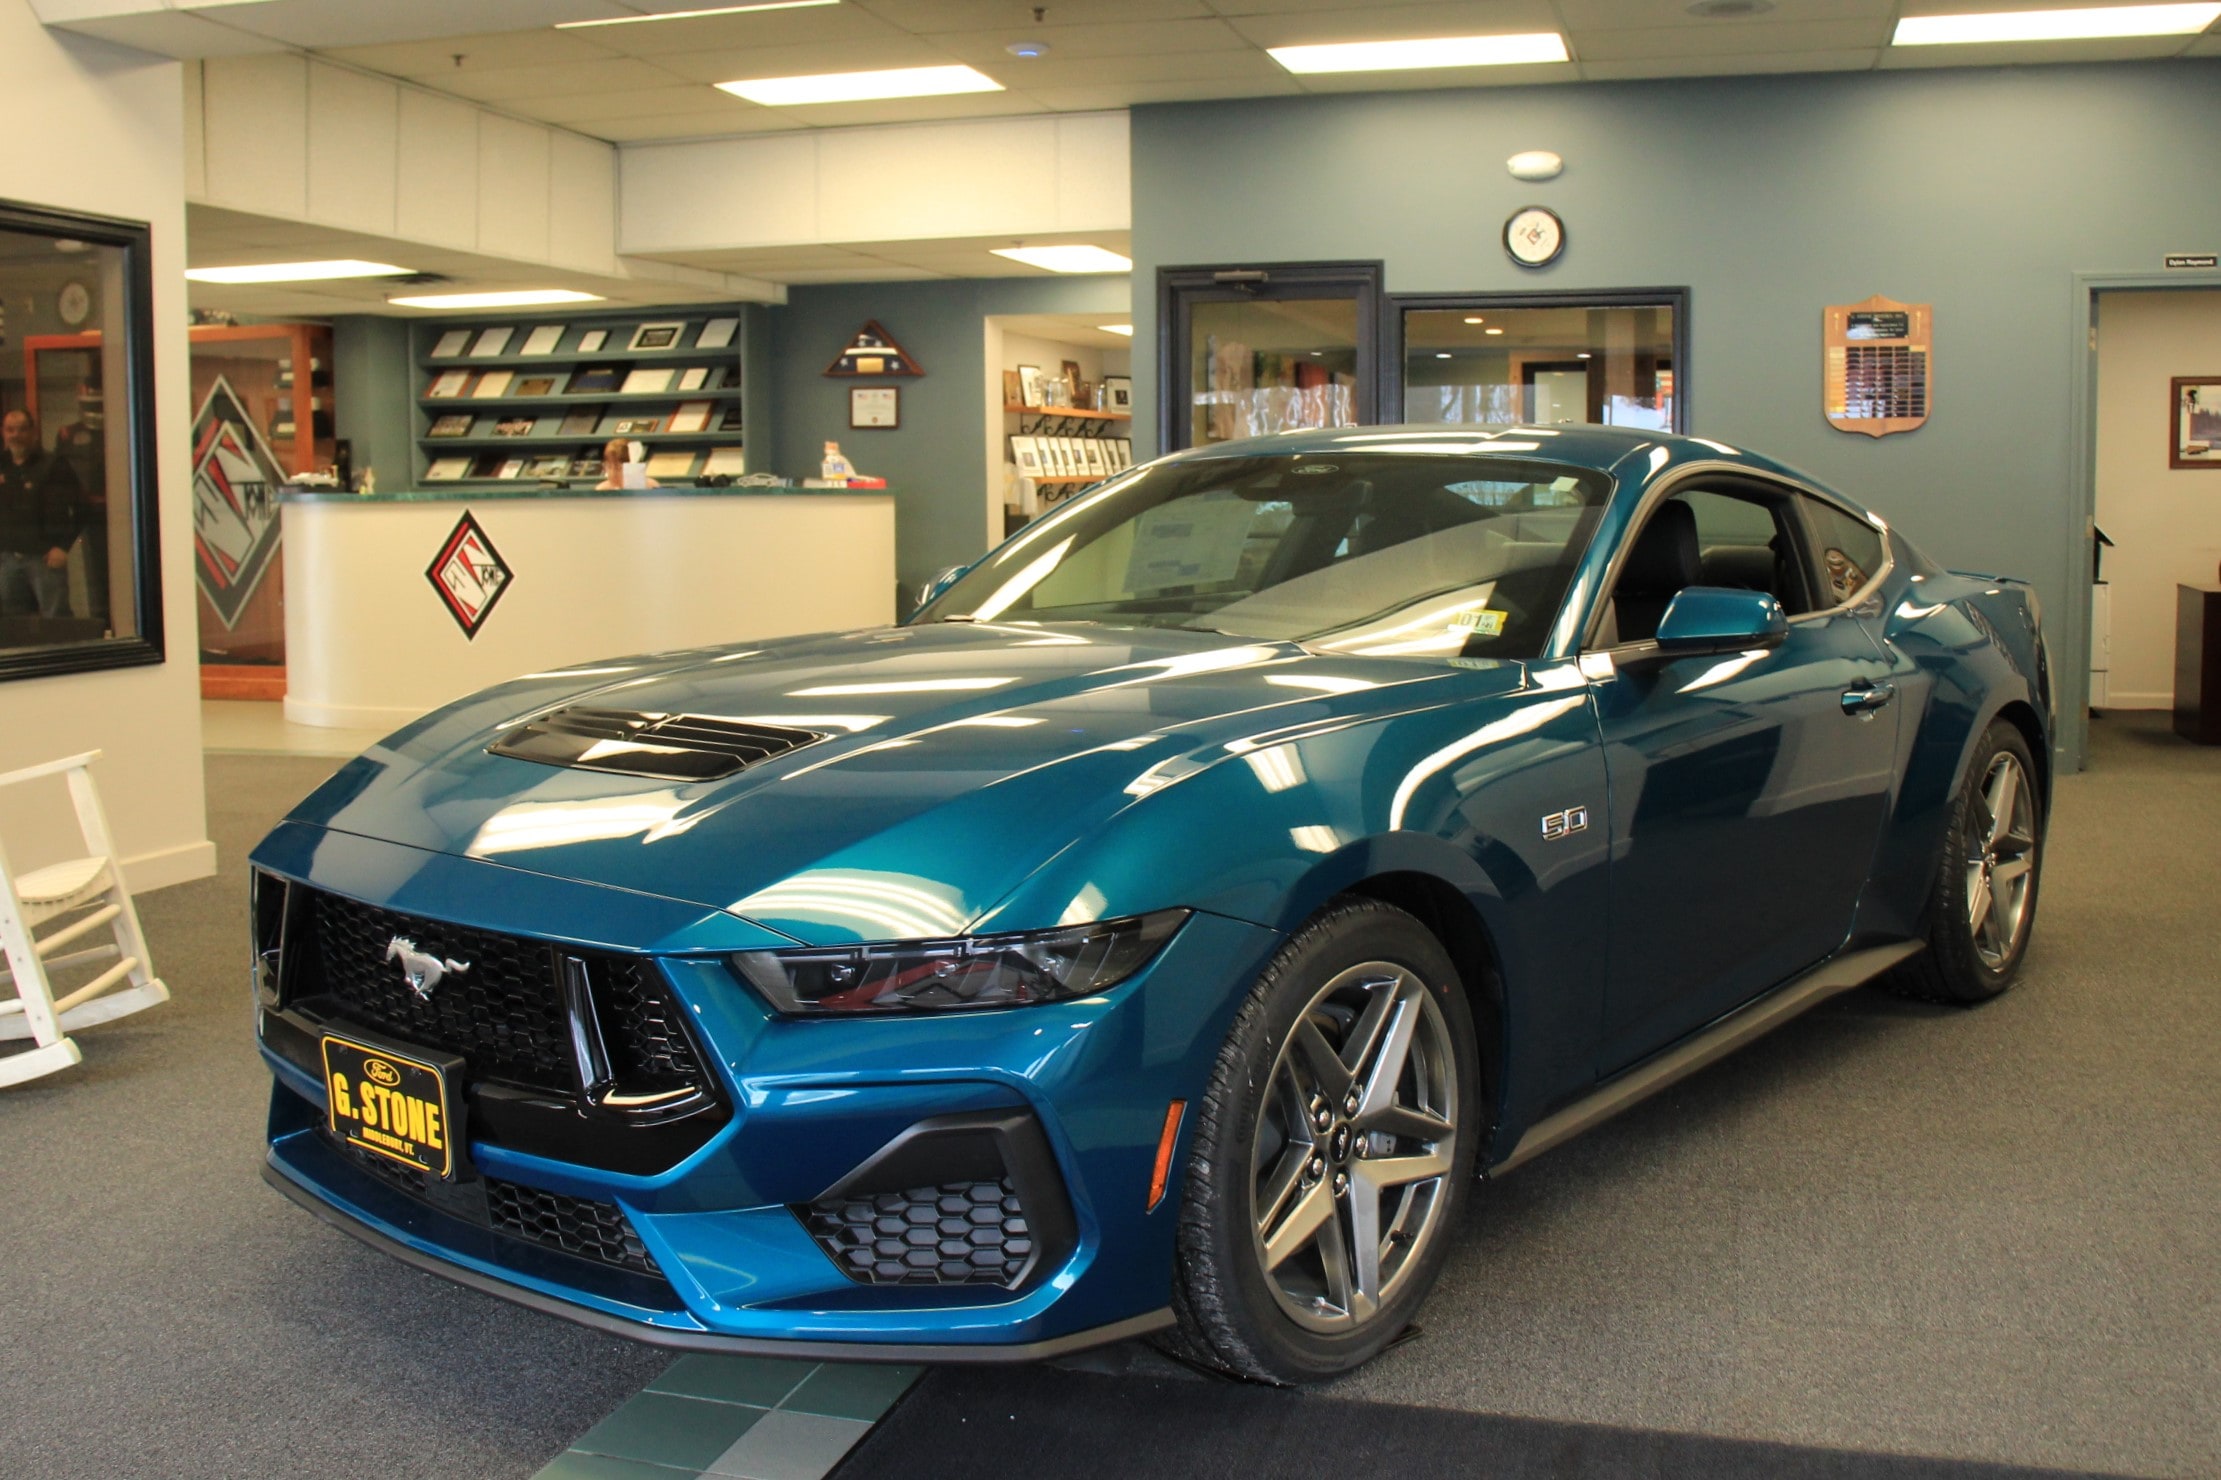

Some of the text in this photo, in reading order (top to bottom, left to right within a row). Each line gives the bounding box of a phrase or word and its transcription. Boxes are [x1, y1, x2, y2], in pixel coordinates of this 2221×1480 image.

[1542, 805, 1587, 840] 5.0
[370, 1062, 394, 1082] Ford
[333, 1072, 442, 1149] G. STONE
